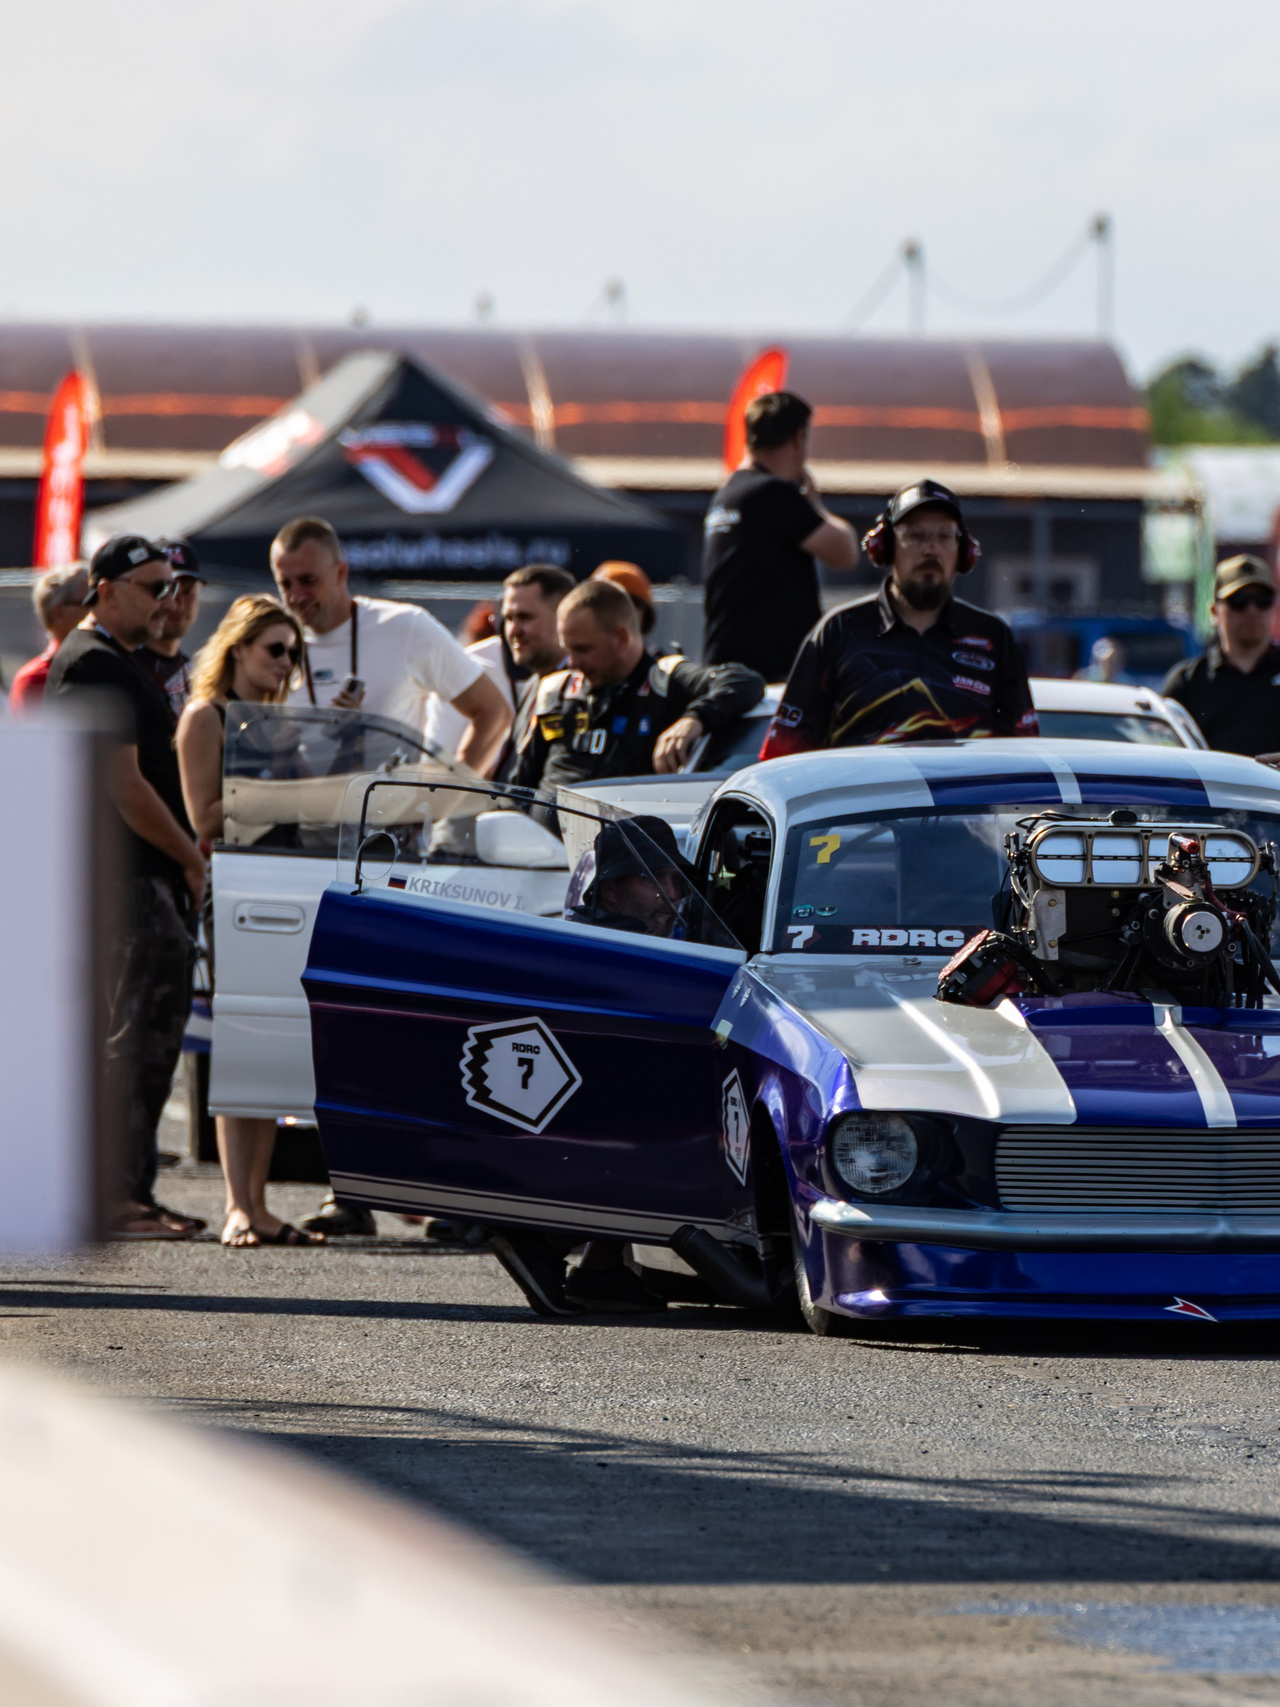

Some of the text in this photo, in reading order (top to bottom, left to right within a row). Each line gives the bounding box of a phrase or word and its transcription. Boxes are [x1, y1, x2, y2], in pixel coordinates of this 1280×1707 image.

[809, 833, 841, 865] 7
[408, 876, 512, 908] KRIKSUNOV
[786, 925, 965, 949] 7 RDRC
[511, 1042, 541, 1055] RDRC
[517, 1057, 534, 1090] 7
